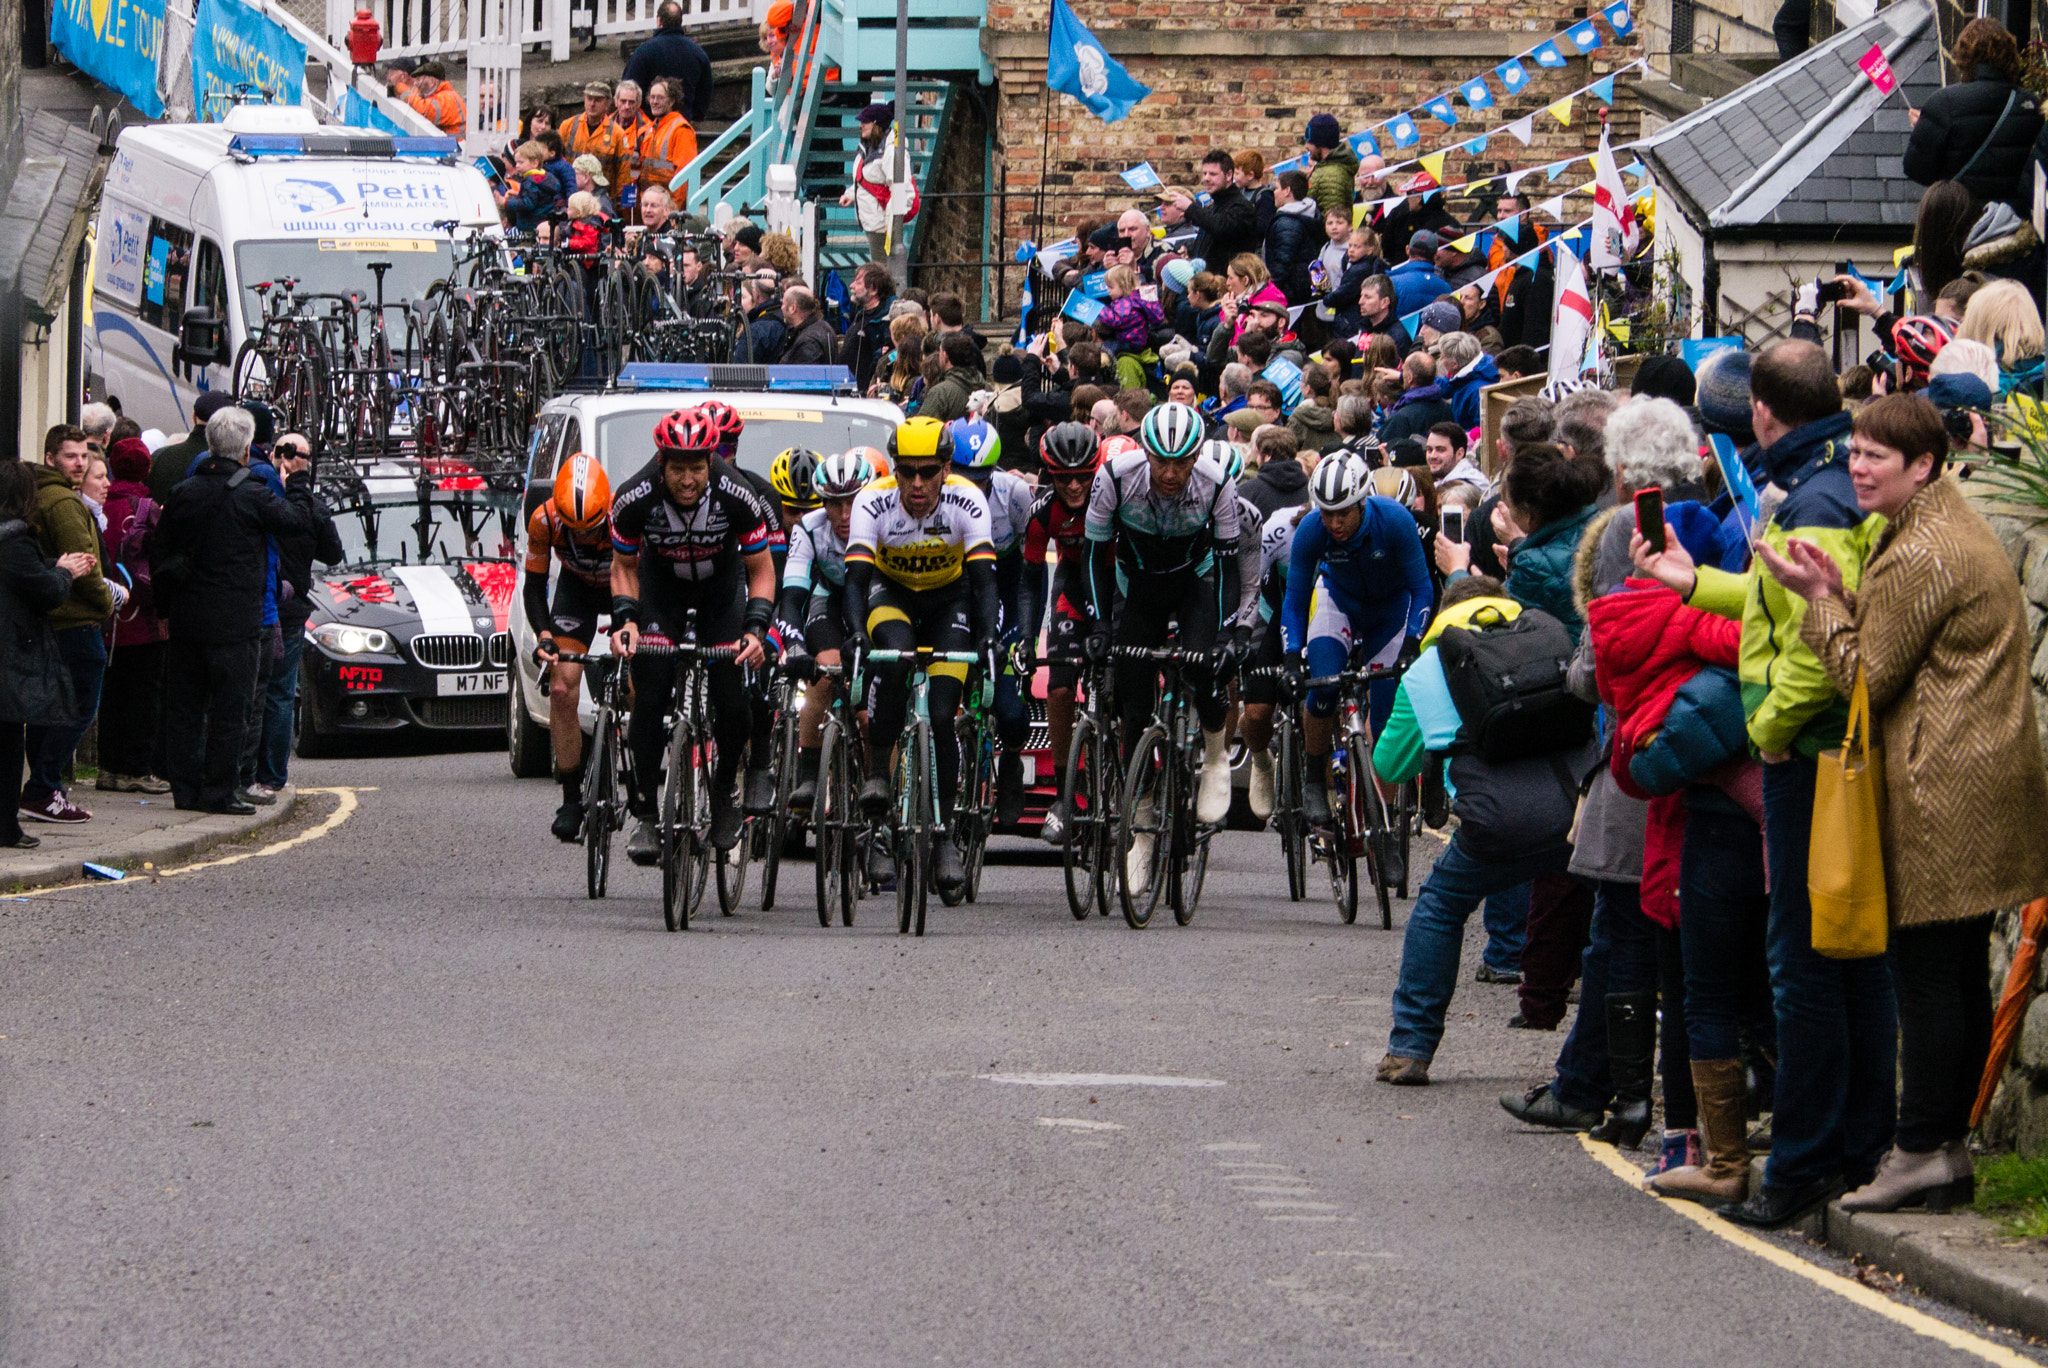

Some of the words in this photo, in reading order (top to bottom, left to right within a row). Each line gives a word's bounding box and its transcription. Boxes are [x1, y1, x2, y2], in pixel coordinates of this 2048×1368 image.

[356, 182, 448, 201] Petit
[122, 229, 140, 257] Petit
[355, 240, 391, 248] OFFICIAL
[719, 474, 762, 519] Sunweb
[663, 531, 728, 545] GIANT
[457, 675, 478, 691] M7
[483, 673, 509, 690] NF
